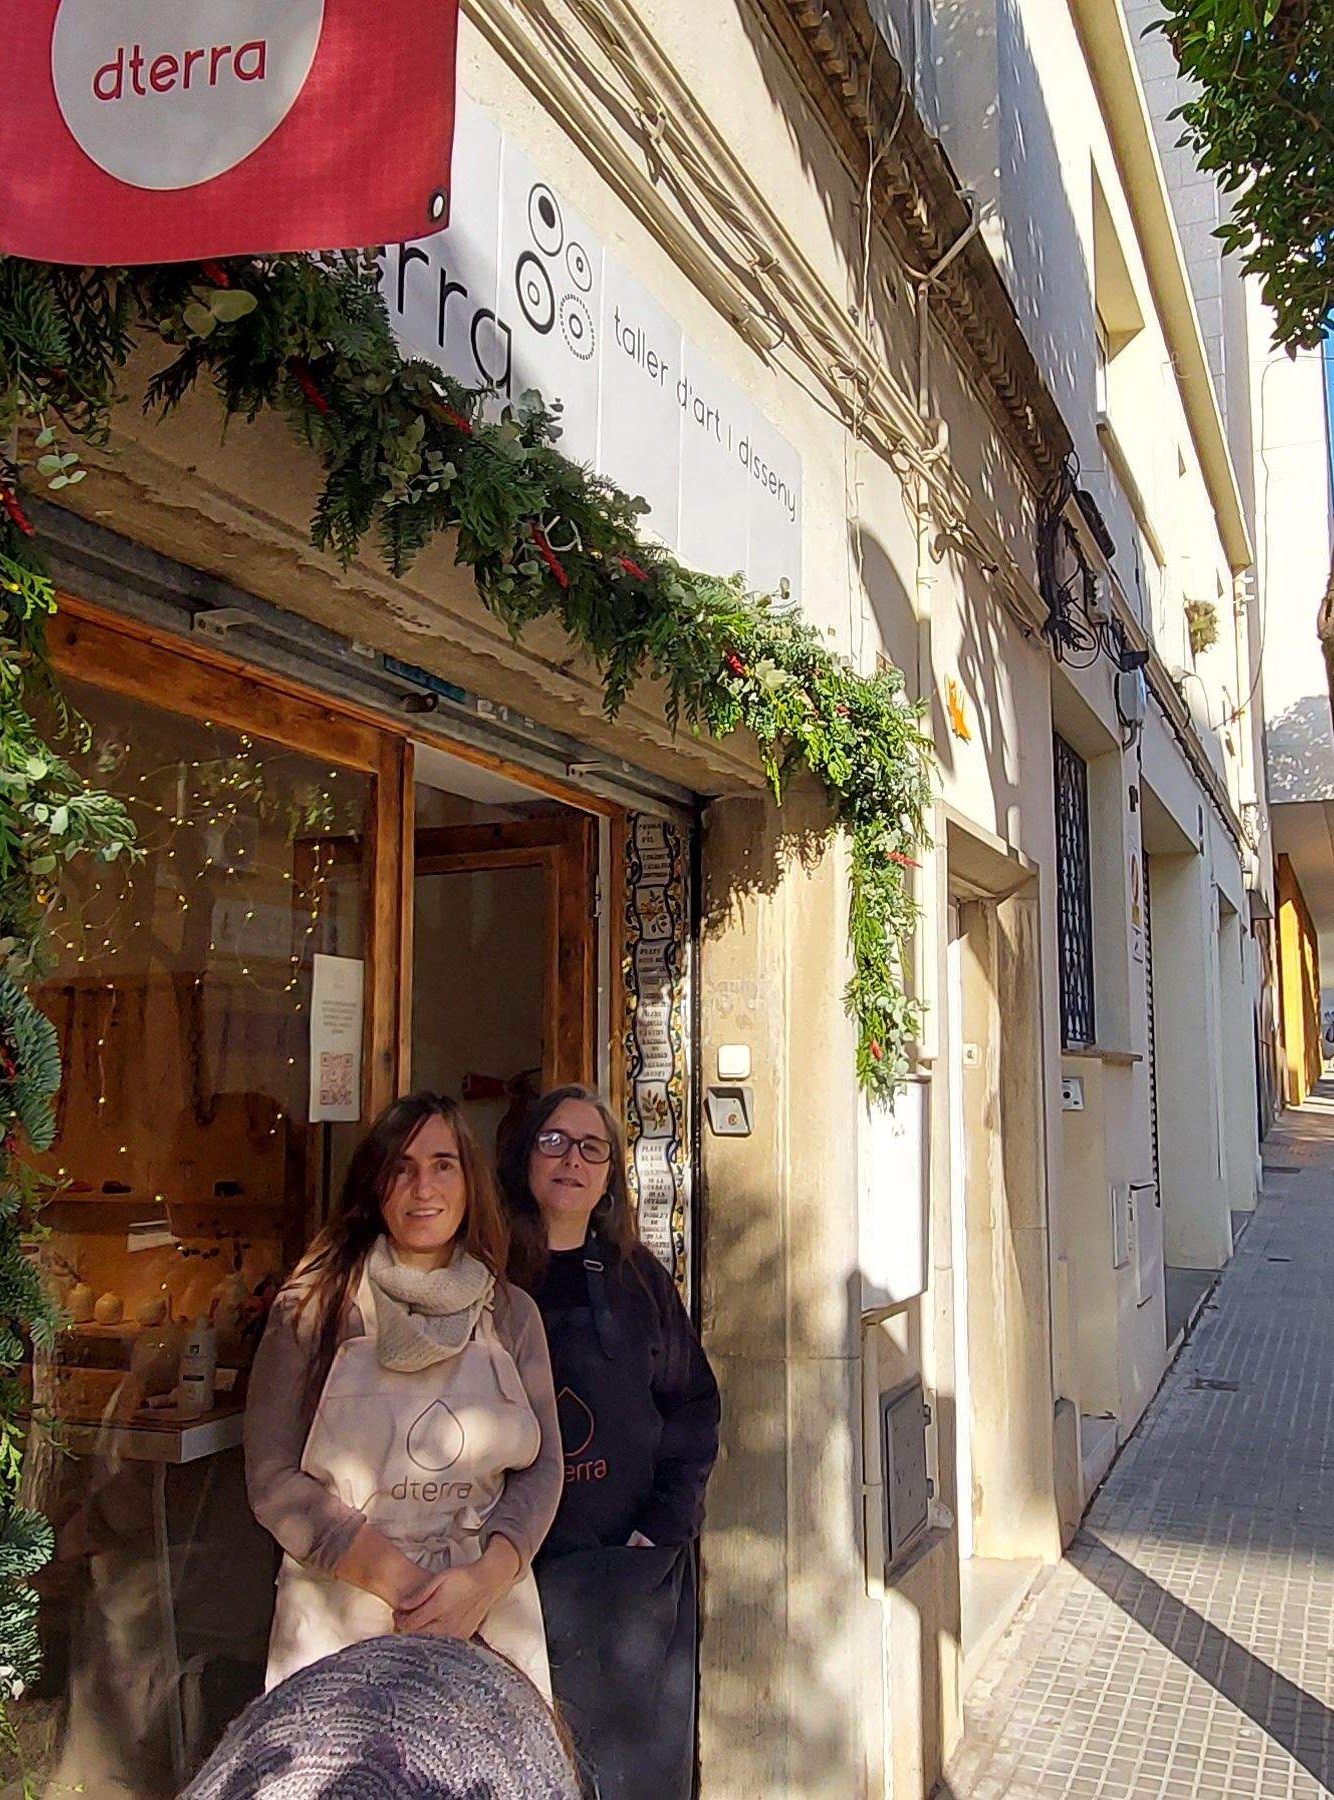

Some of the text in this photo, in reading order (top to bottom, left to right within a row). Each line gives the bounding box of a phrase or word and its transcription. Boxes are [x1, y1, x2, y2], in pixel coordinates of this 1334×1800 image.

[93, 39, 266, 101] dterra
[377, 243, 513, 399] rra
[614, 304, 669, 387] taller
[676, 376, 722, 443] d'art
[738, 435, 796, 522] disseny
[391, 1476, 473, 1502] dterra
